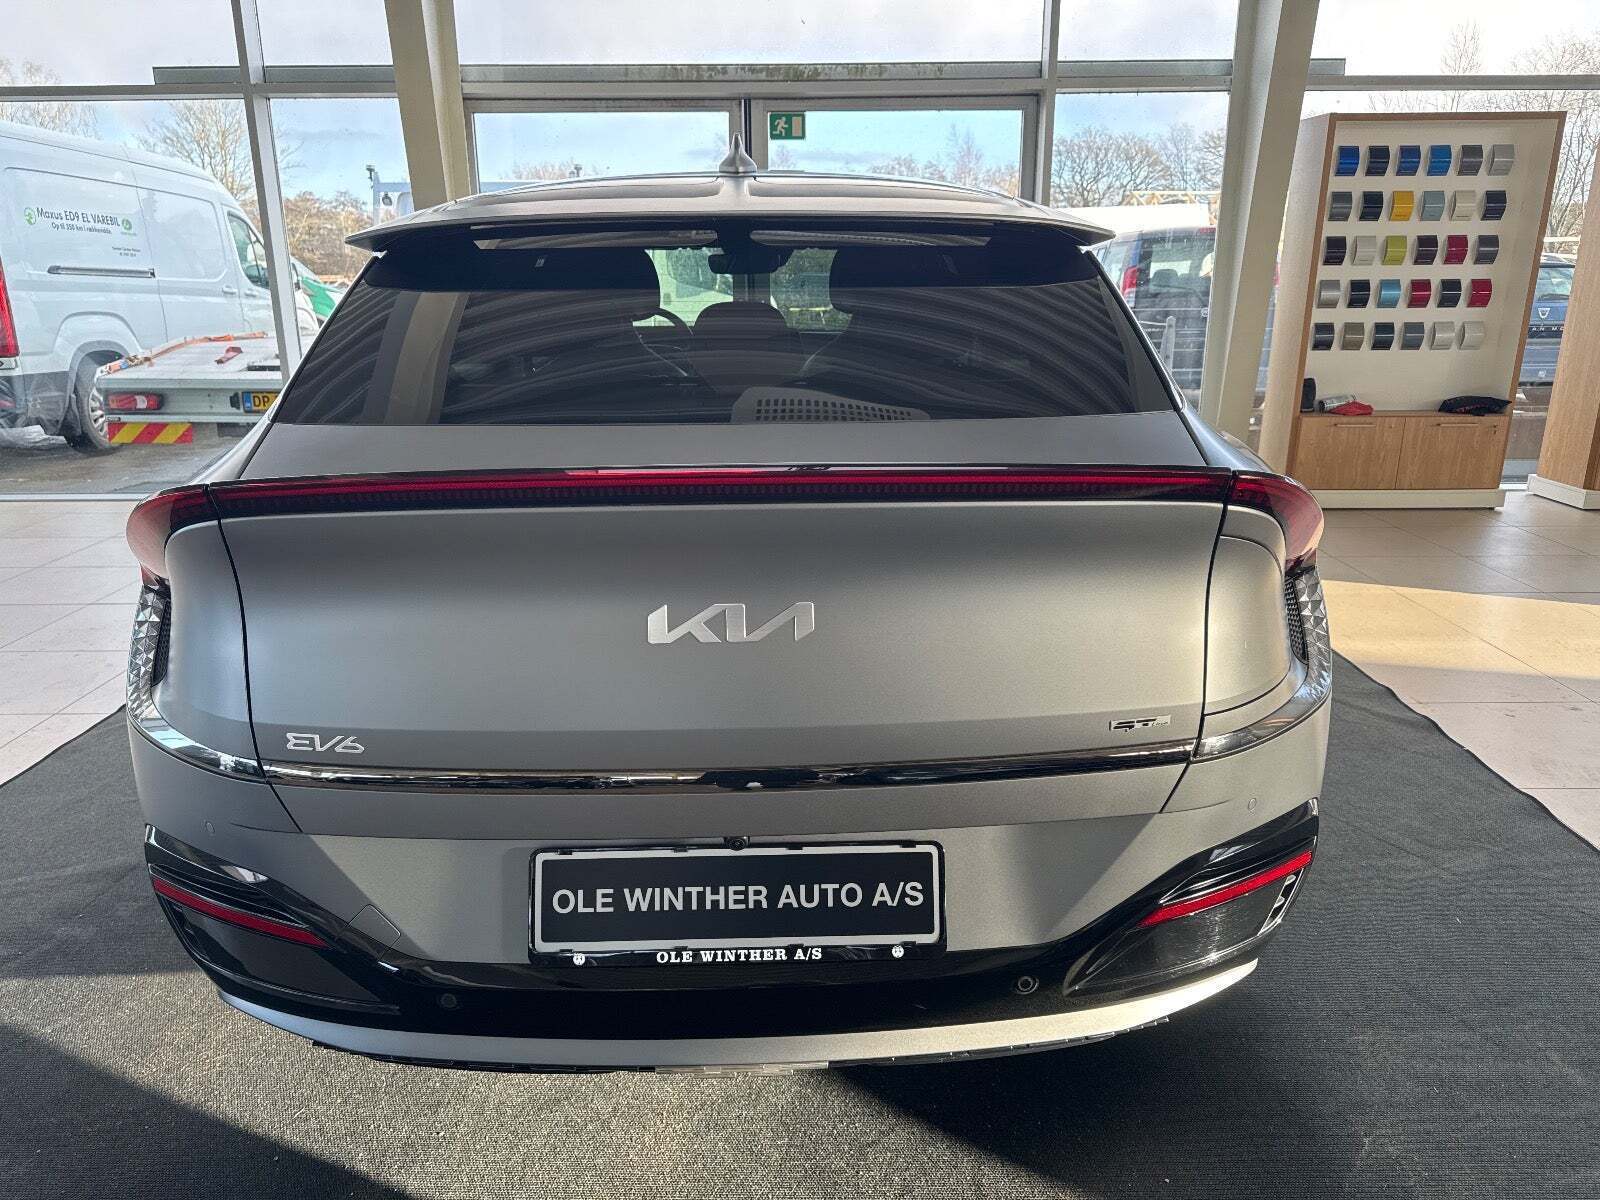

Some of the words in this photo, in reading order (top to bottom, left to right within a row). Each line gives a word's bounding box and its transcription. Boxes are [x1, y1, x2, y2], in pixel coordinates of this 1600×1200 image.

[36, 207, 63, 221] Maxus
[64, 210, 80, 222] ED9
[81, 212, 91, 223] EL
[91, 213, 121, 227] VAREBIL
[51, 222, 60, 231] Op
[648, 601, 815, 644] KIA
[286, 732, 365, 754] EV6
[552, 888, 614, 914] OLE
[623, 885, 769, 912] WINTHER
[777, 882, 863, 909] AUTO
[871, 881, 924, 907] A/S
[656, 951, 693, 964] OLE
[700, 948, 788, 963] WINTHER
[793, 947, 822, 961] A/S
